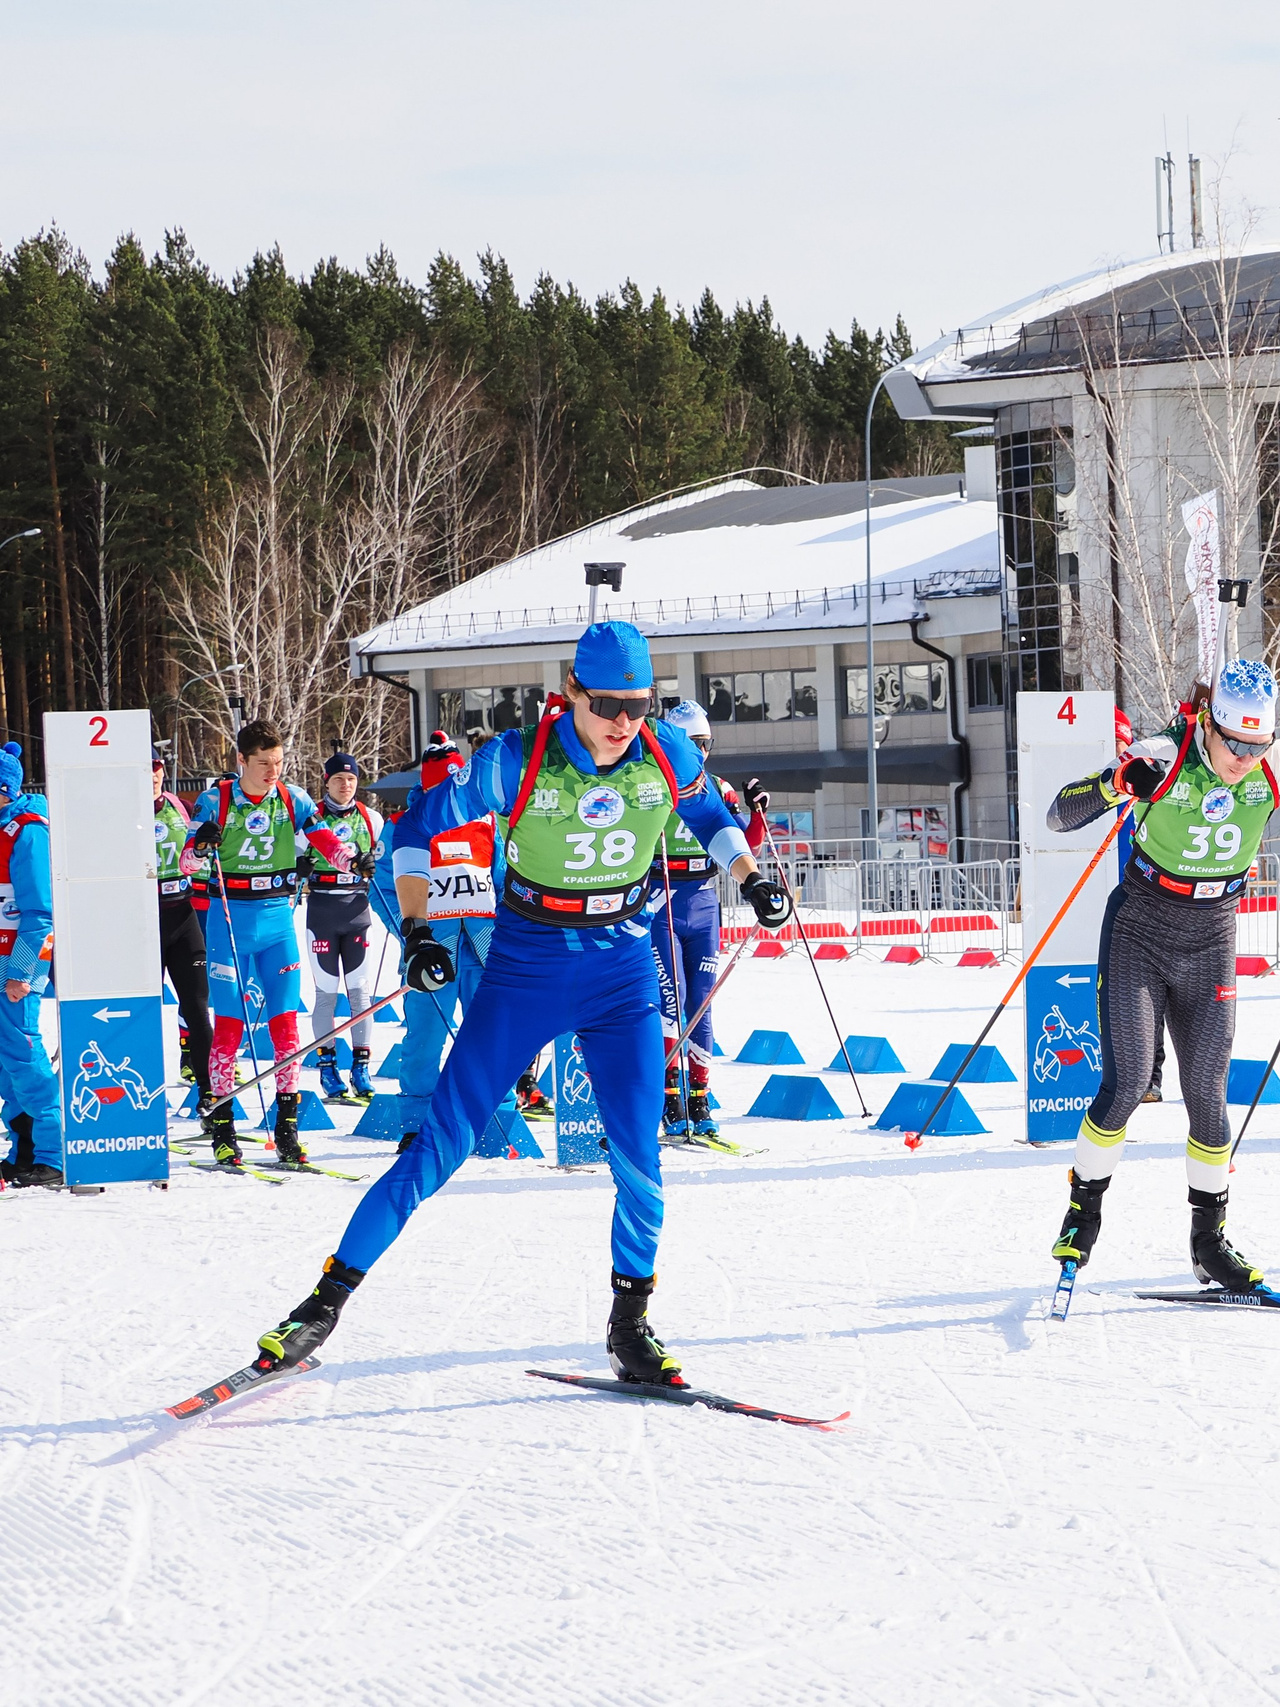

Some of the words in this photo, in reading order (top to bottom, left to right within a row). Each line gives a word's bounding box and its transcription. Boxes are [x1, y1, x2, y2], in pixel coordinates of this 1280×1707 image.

[1057, 697, 1077, 725] 4
[88, 716, 110, 747] 2
[238, 836, 276, 861] 43
[564, 829, 637, 870] 38
[1181, 823, 1242, 861] 39
[563, 870, 629, 884] КРАСНОЯРСК
[1178, 863, 1235, 874] КРАСНОЯРСК
[1029, 1097, 1097, 1113] КРАСНОЯ
[66, 1134, 167, 1156] КРАСНОЯРСК
[616, 1278, 632, 1289] 188
[1219, 1294, 1261, 1306] SALOMON
